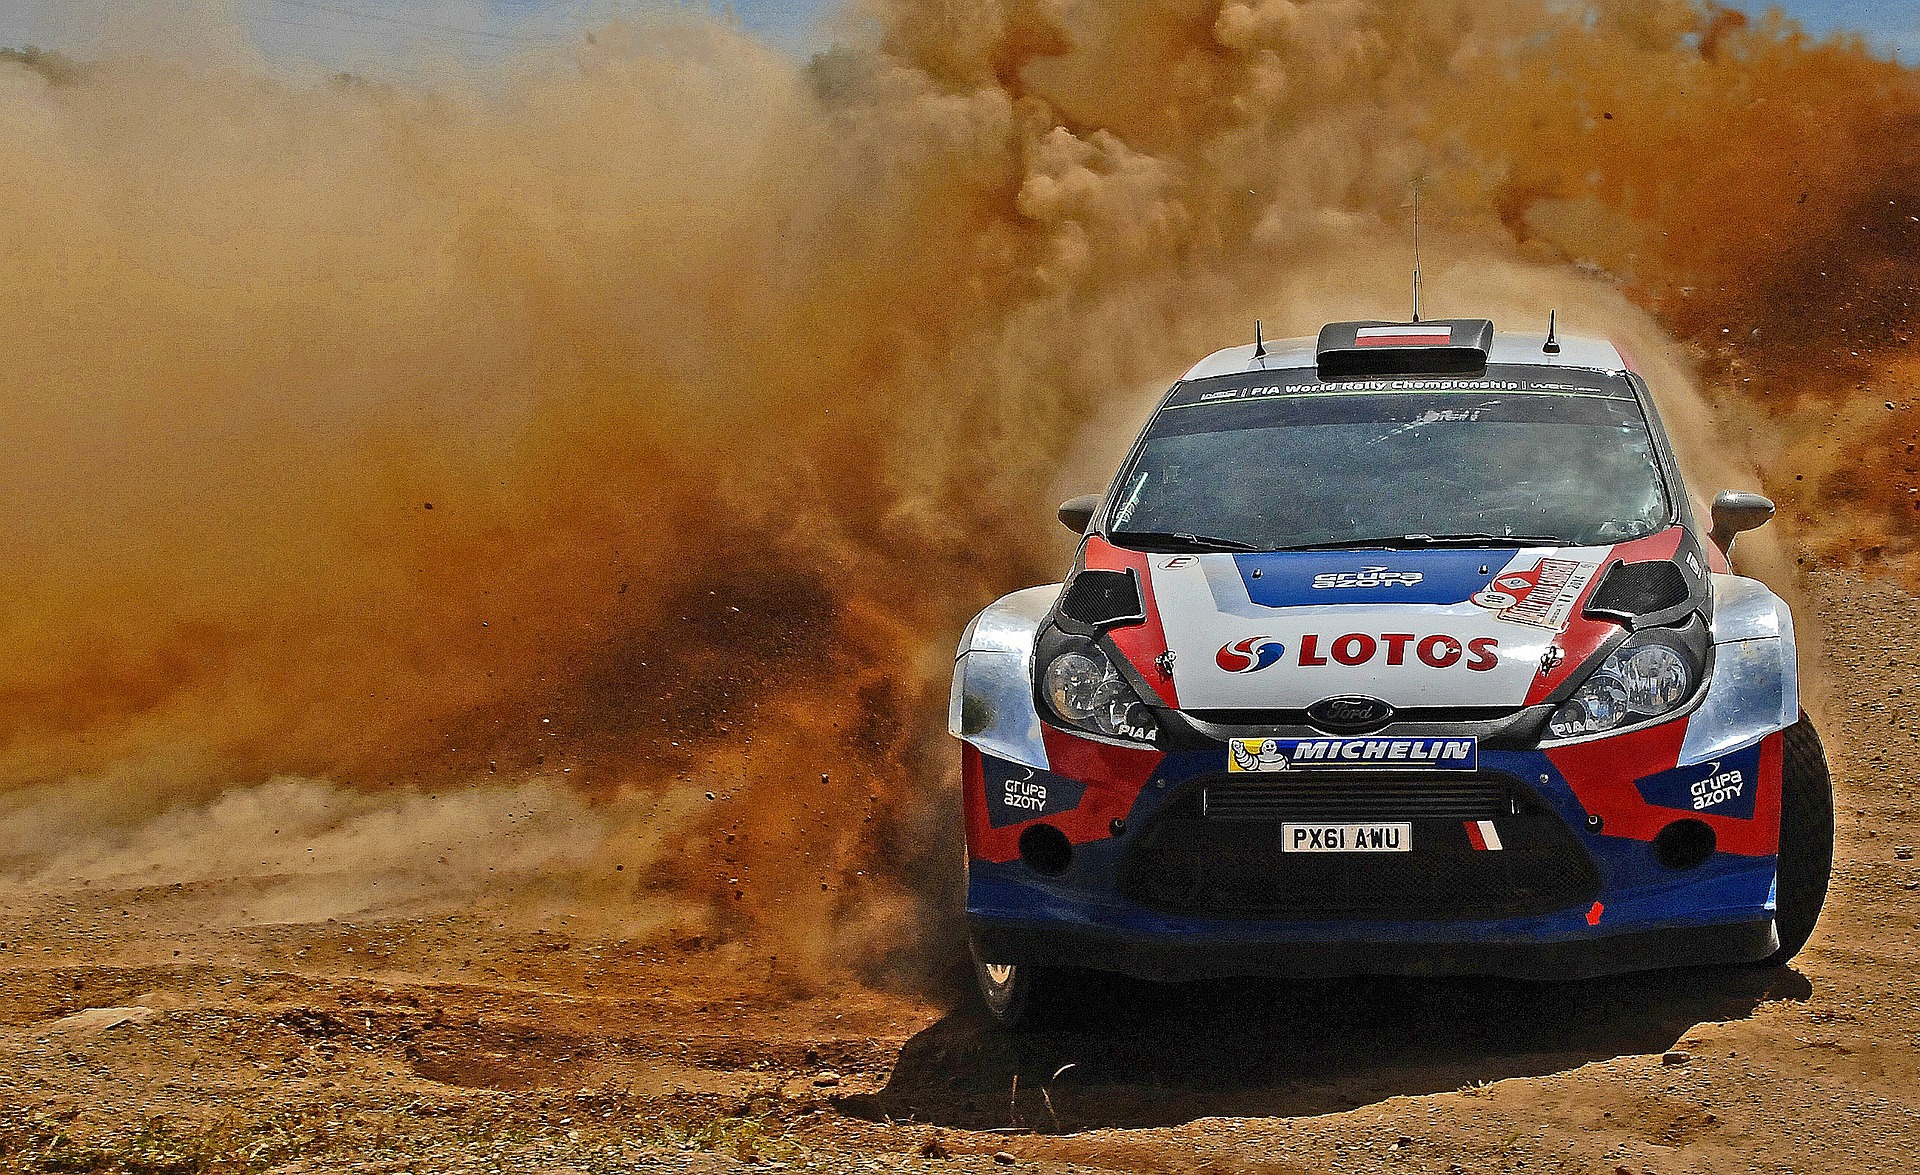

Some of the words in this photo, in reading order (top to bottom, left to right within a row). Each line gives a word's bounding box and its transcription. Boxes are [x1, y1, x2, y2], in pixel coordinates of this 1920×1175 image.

[1285, 382, 1337, 393] World
[1341, 380, 1387, 391] Rally
[1391, 380, 1518, 391] Championship
[1297, 632, 1500, 672] LOTOS
[1326, 700, 1374, 719] Ford
[1118, 724, 1158, 741] PIAA
[1293, 741, 1472, 760] MICHELIN
[1293, 828, 1345, 849] PX61
[1355, 828, 1400, 849] AWU
